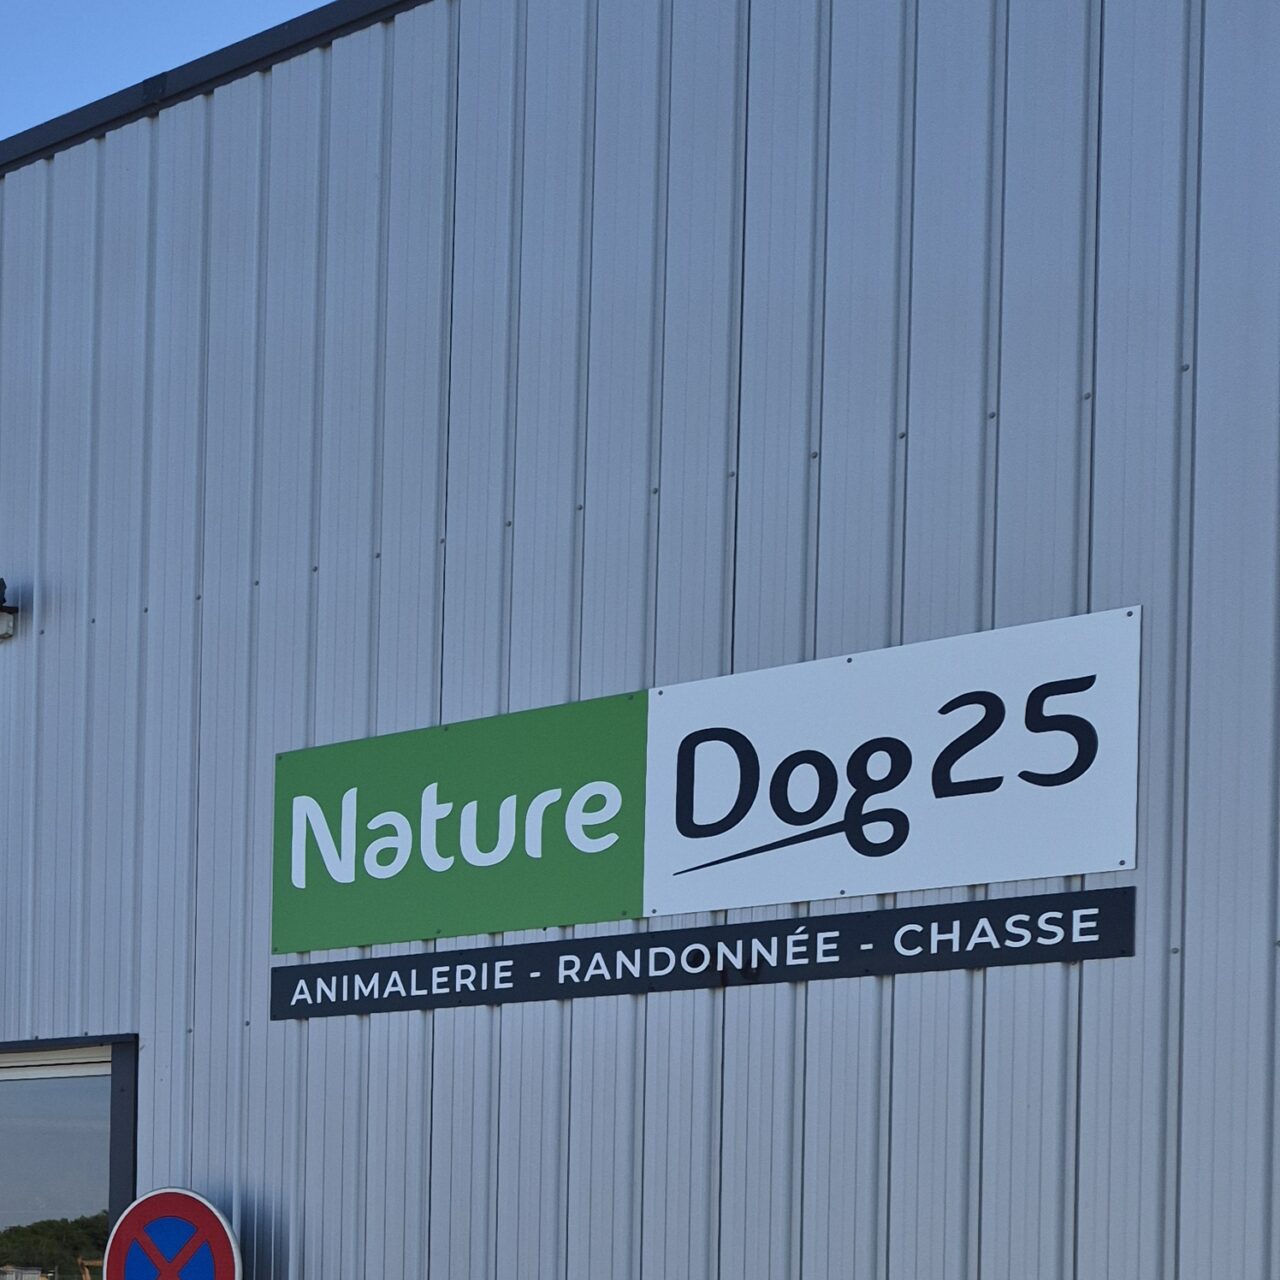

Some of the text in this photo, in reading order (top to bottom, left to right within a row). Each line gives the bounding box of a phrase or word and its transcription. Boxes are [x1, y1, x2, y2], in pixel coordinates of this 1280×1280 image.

[291, 780, 622, 890] Nature
[290, 959, 514, 1006] ANIMALERIE
[558, 925, 840, 984] RANDONNÉE
[893, 907, 1100, 957] CHASSE
